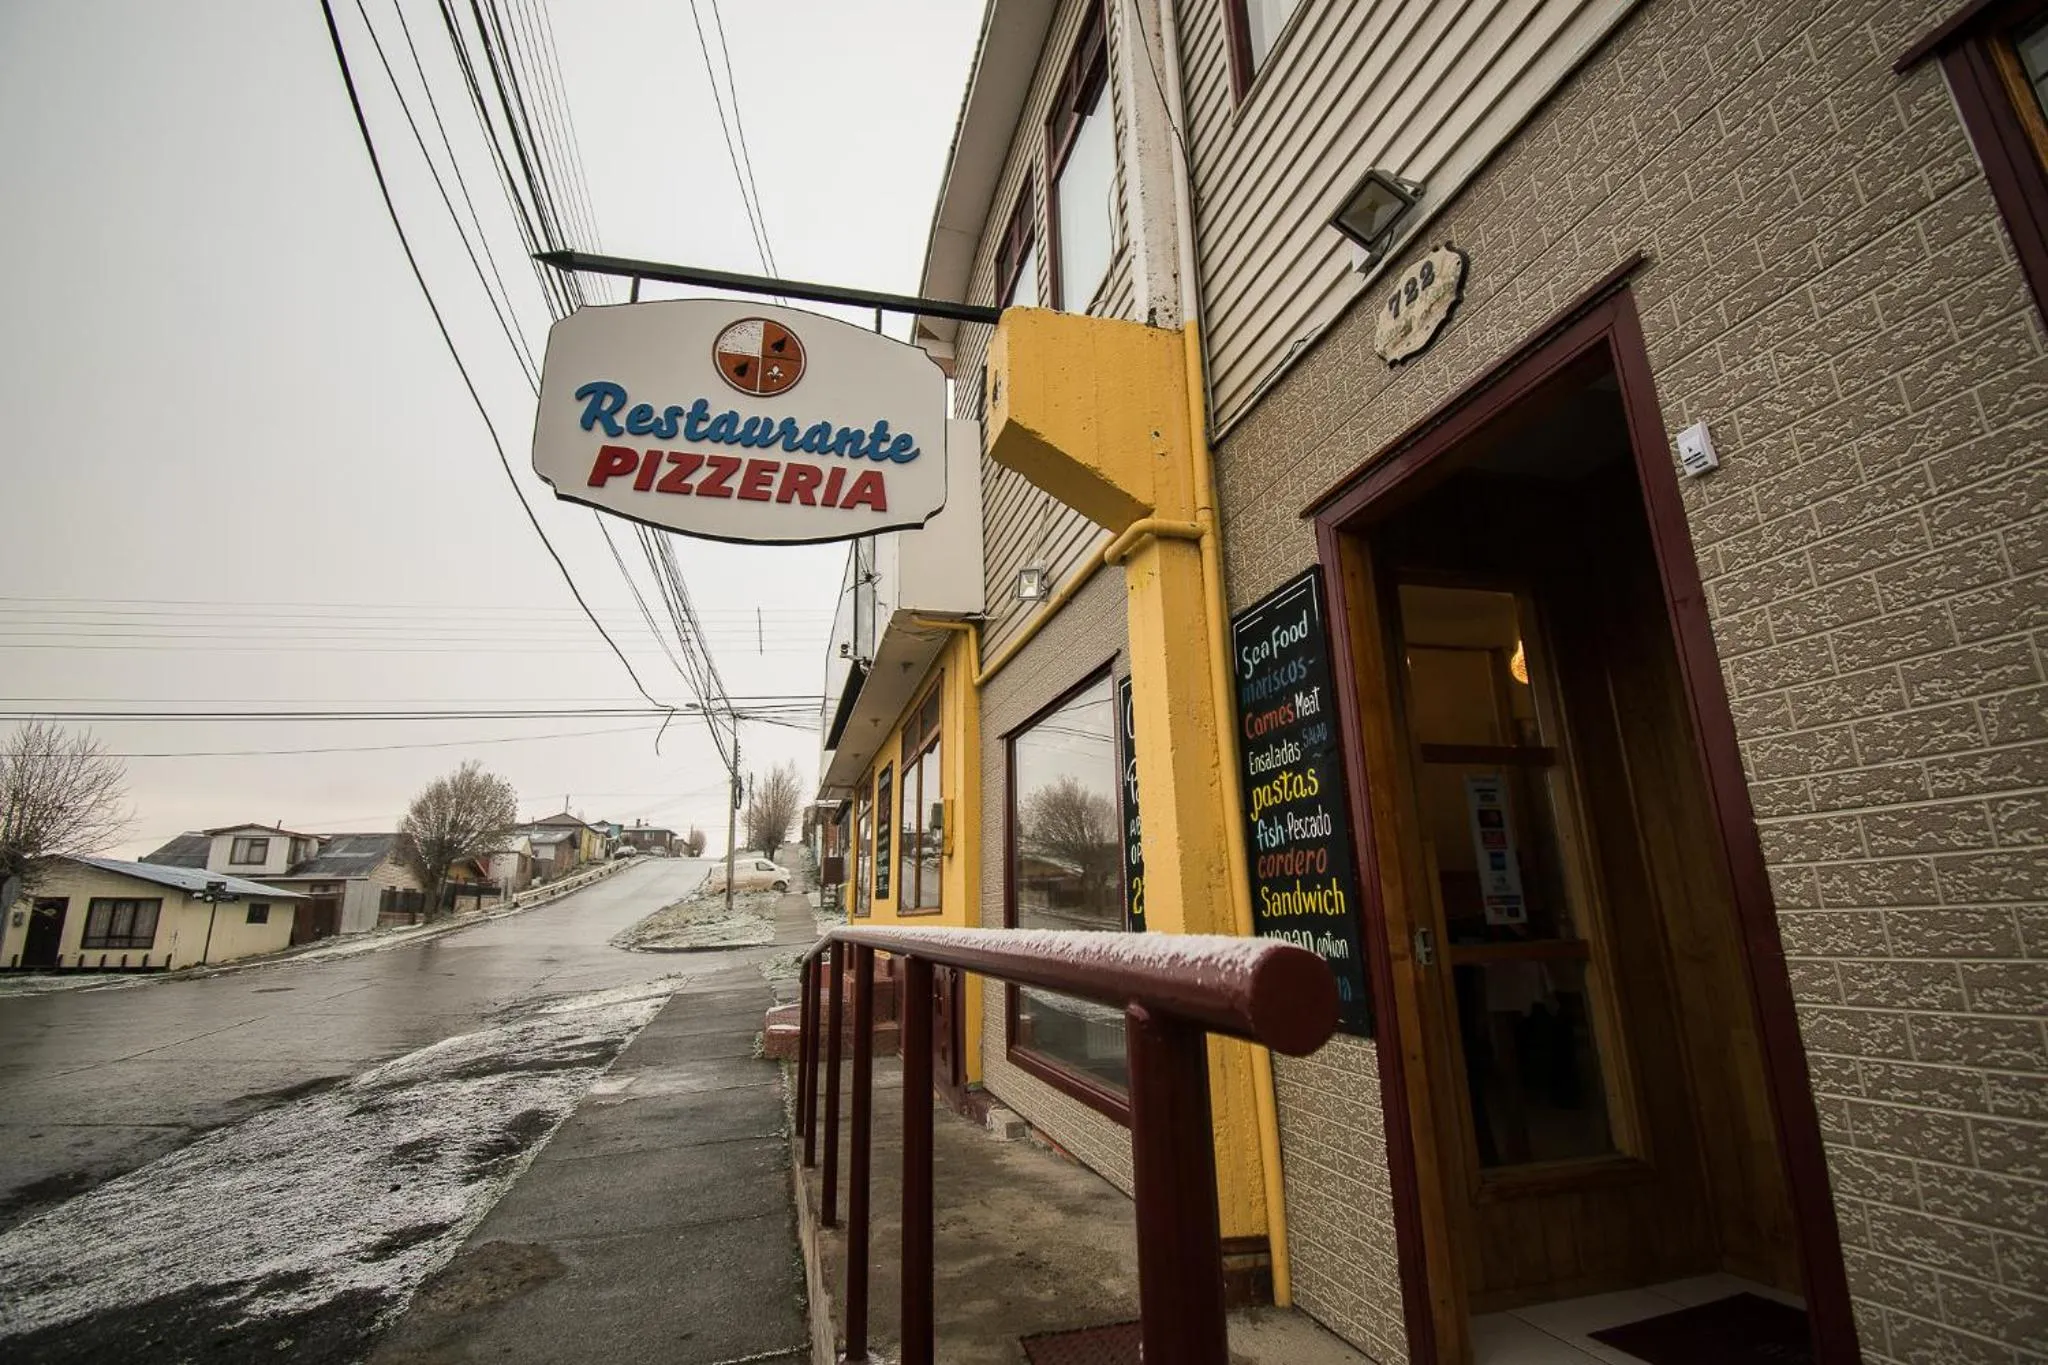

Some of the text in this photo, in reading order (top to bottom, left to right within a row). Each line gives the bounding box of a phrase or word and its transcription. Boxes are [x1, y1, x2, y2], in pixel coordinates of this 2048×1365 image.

[574, 381, 920, 464] Restaurante
[587, 445, 888, 512] PIZZERIA
[1294, 685, 1320, 719] Meat
[1249, 738, 1301, 775] Ensaladas
[1250, 768, 1319, 822] pastas
[1261, 877, 1346, 918] Sandwich
